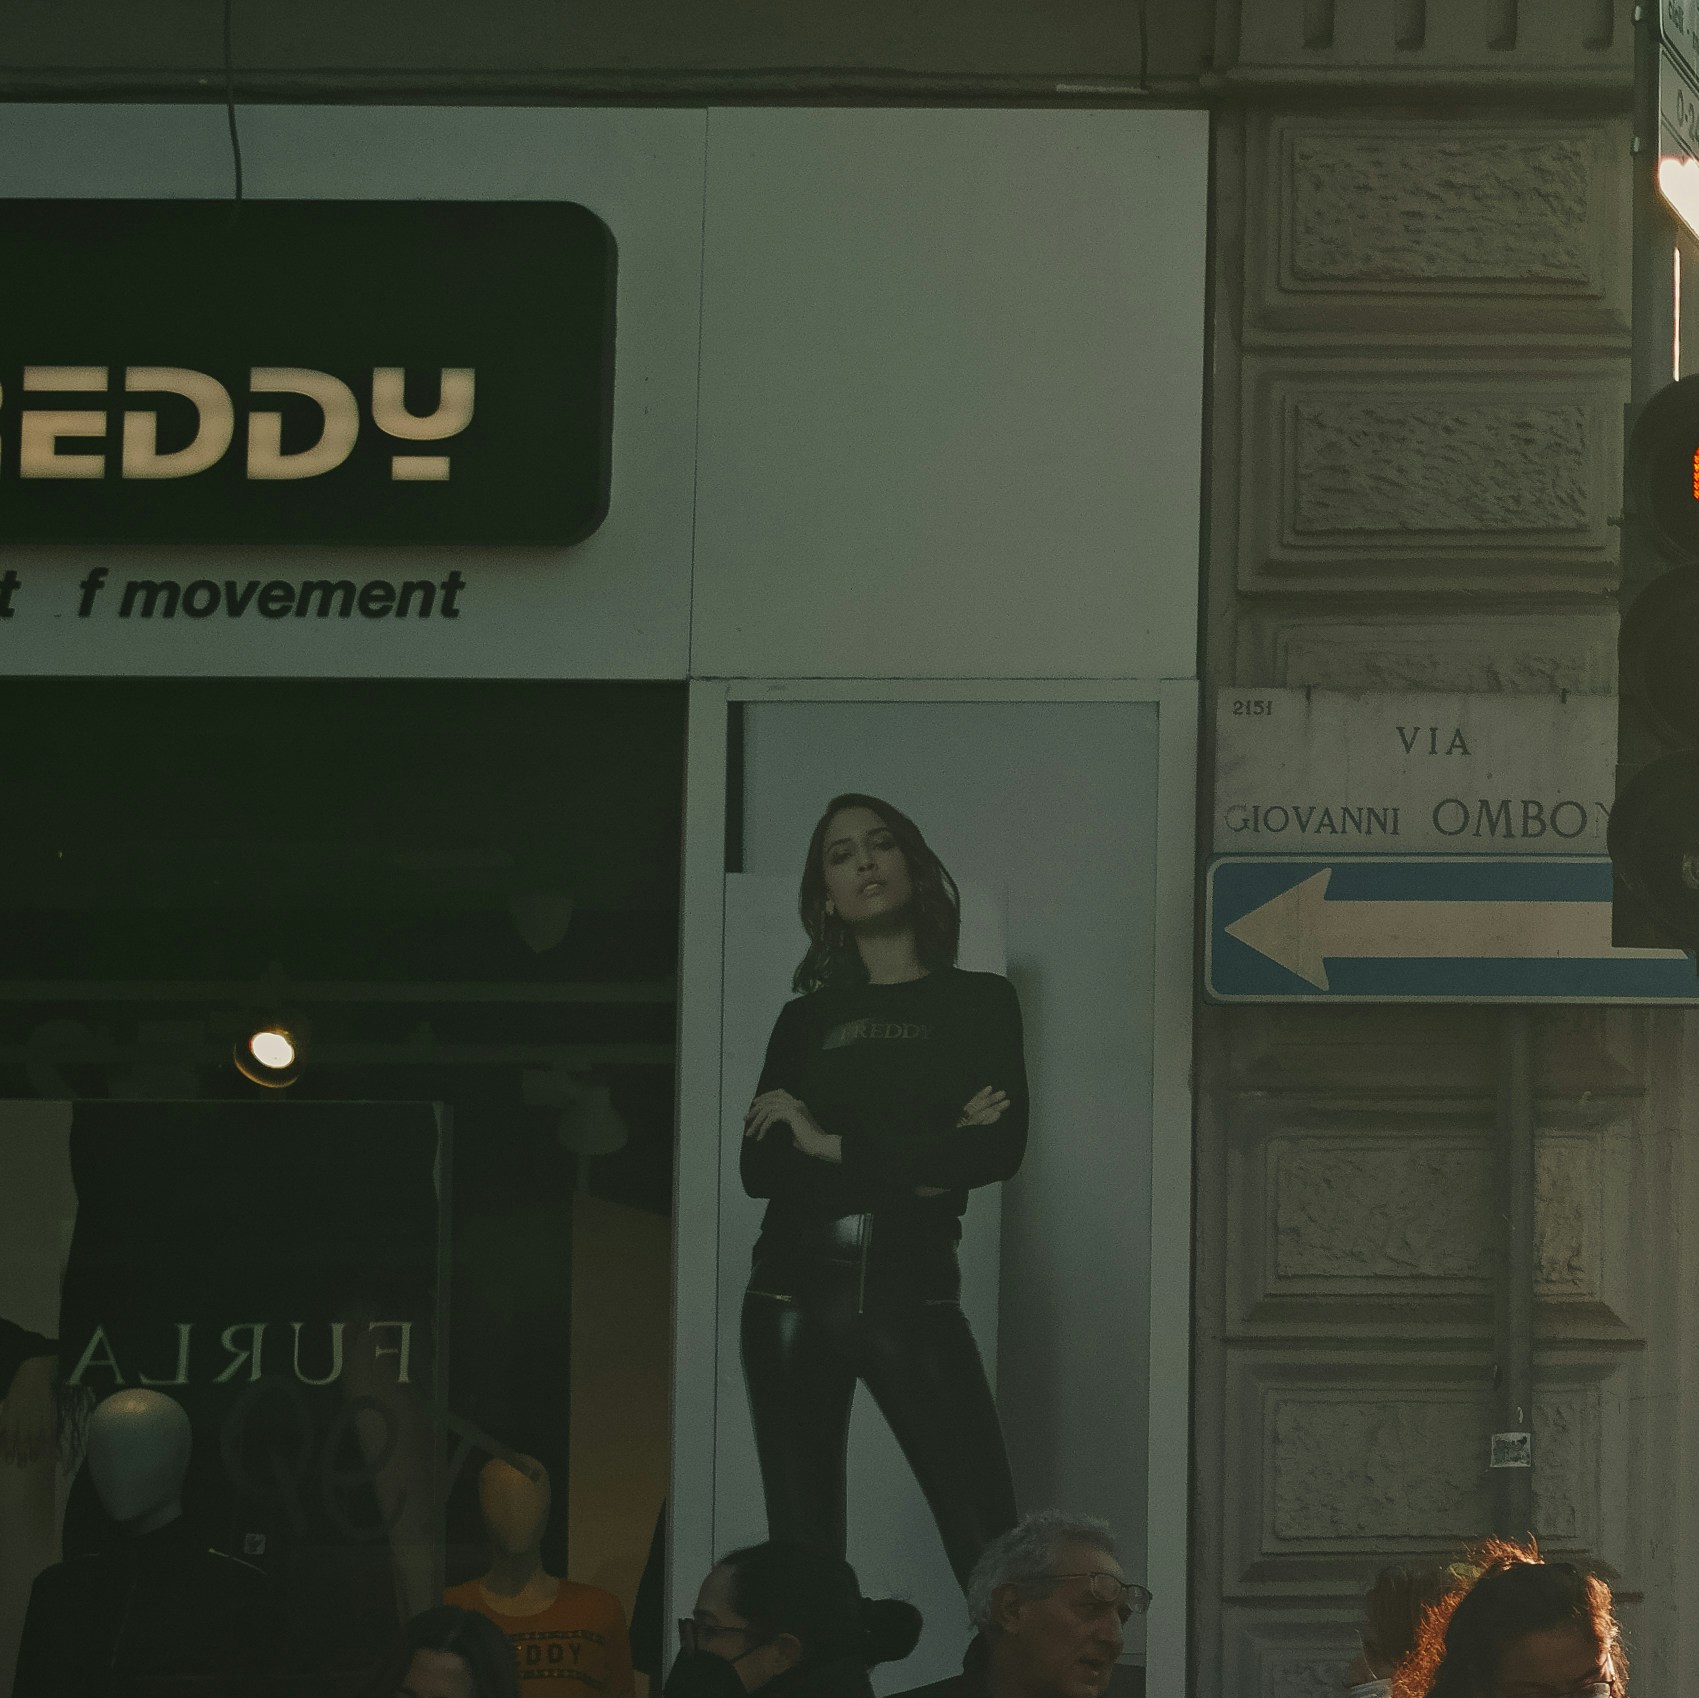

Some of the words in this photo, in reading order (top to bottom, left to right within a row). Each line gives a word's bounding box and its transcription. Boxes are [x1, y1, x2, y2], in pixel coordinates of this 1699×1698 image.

[0, 365, 476, 482] EDDY
[117, 570, 467, 620] movement
[1231, 699, 1274, 717] 2151
[1395, 726, 1472, 756] VIA
[1223, 803, 1400, 836] GIOVANNI
